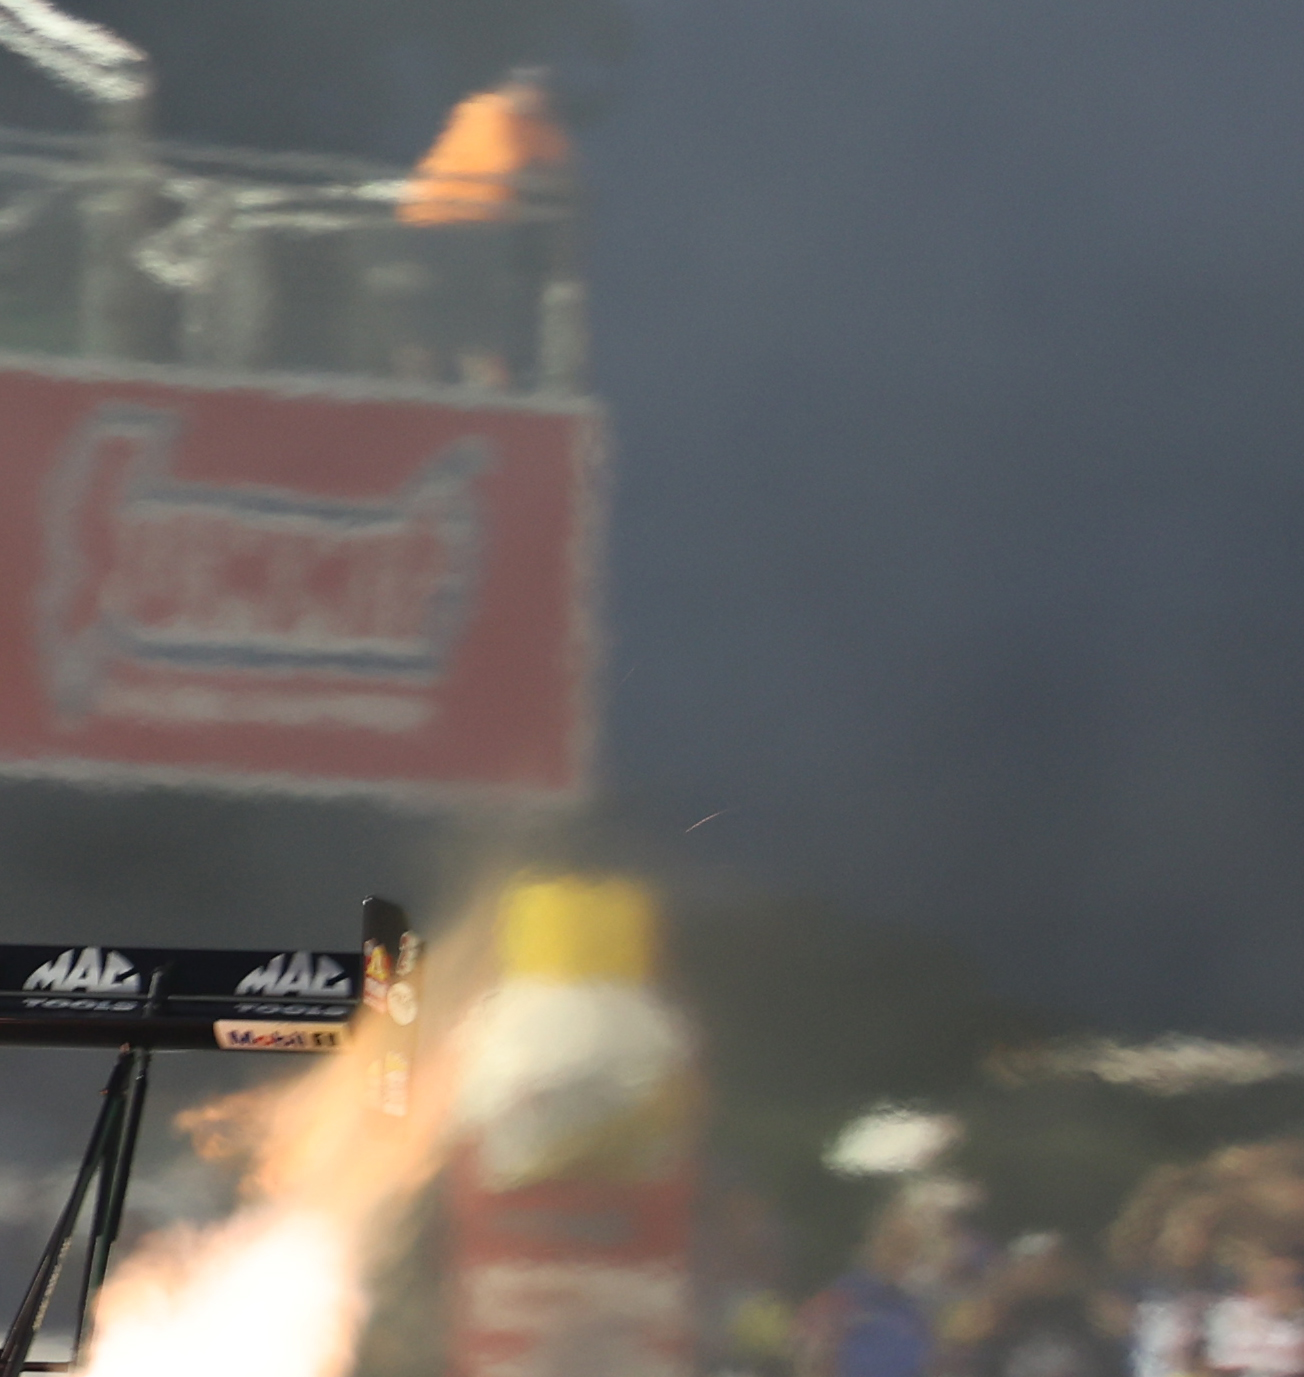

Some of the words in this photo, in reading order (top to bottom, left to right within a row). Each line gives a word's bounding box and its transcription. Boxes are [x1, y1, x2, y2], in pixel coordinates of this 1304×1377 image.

[21, 946, 141, 993] MAC
[234, 952, 353, 997] MAC
[228, 1030, 304, 1046] Mobil
